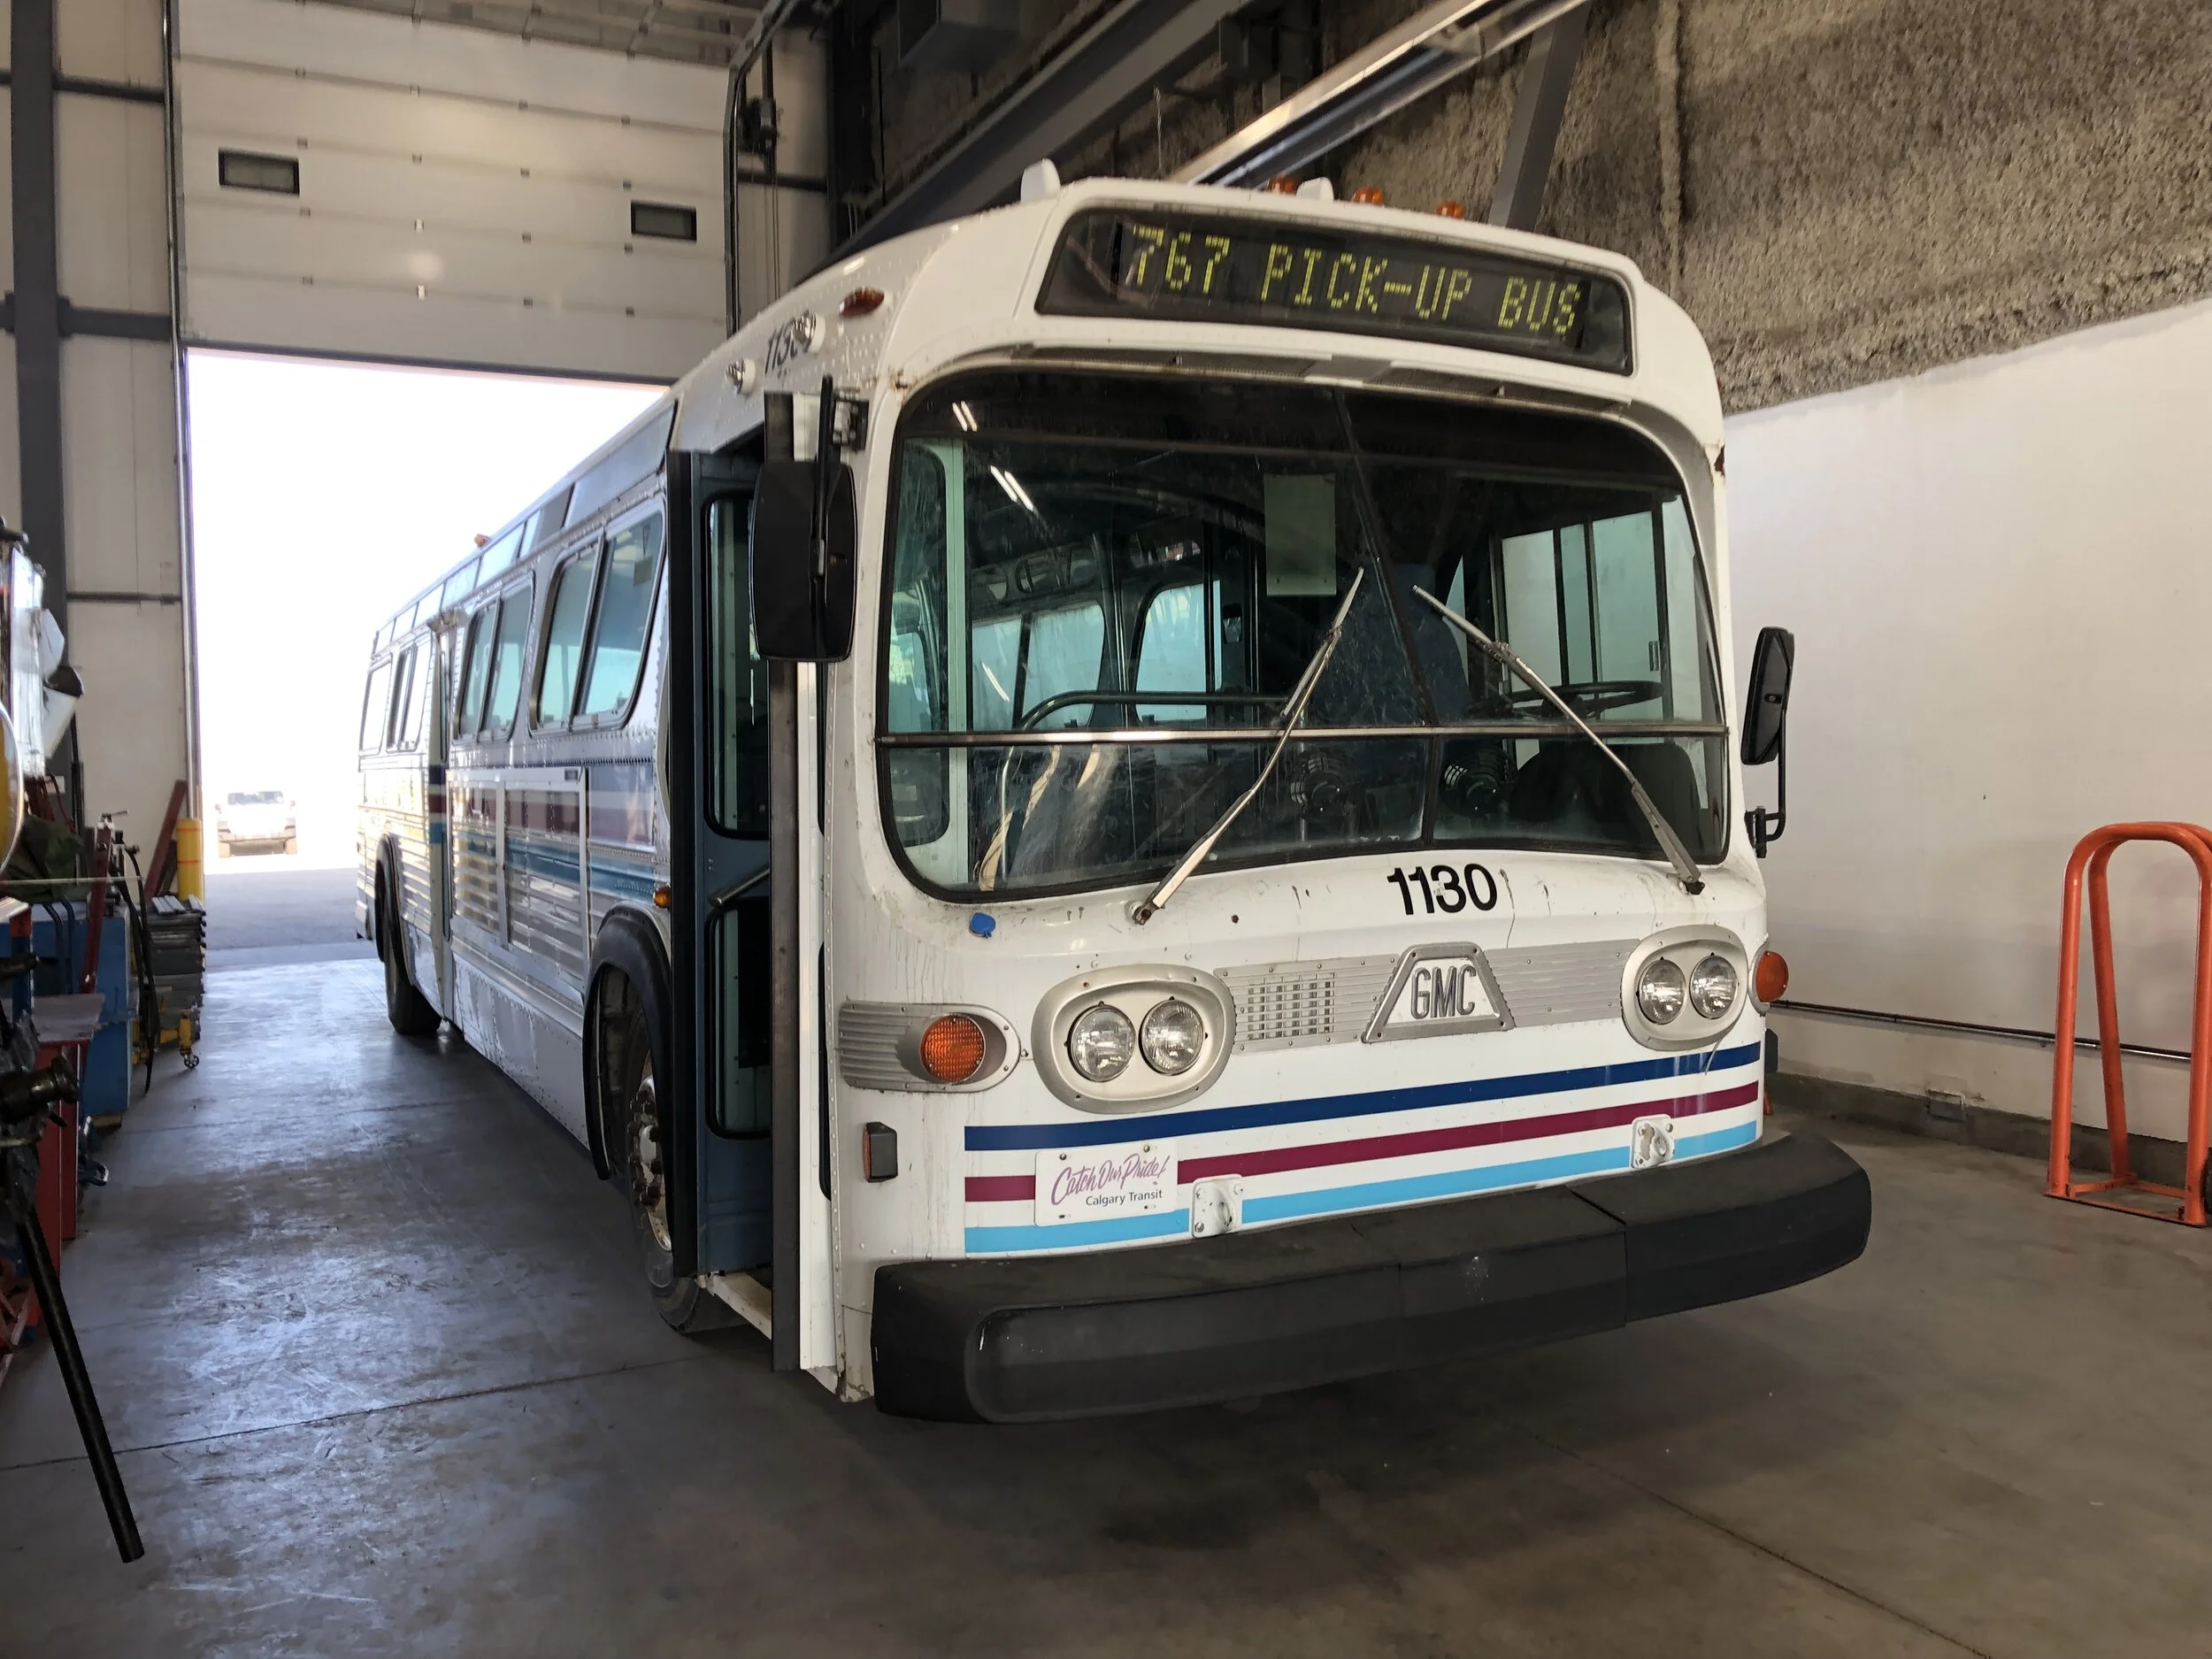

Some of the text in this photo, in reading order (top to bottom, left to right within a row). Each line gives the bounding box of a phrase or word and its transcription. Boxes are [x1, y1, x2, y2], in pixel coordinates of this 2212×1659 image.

[1133, 225, 1581, 334] 767 PICK-UP BUS
[1386, 863, 1498, 916] 1130
[1410, 964, 1477, 1019] GMC
[1050, 1153, 1171, 1206] Catch Our Pride!
[1085, 1189, 1164, 1208] Calgary Transit
